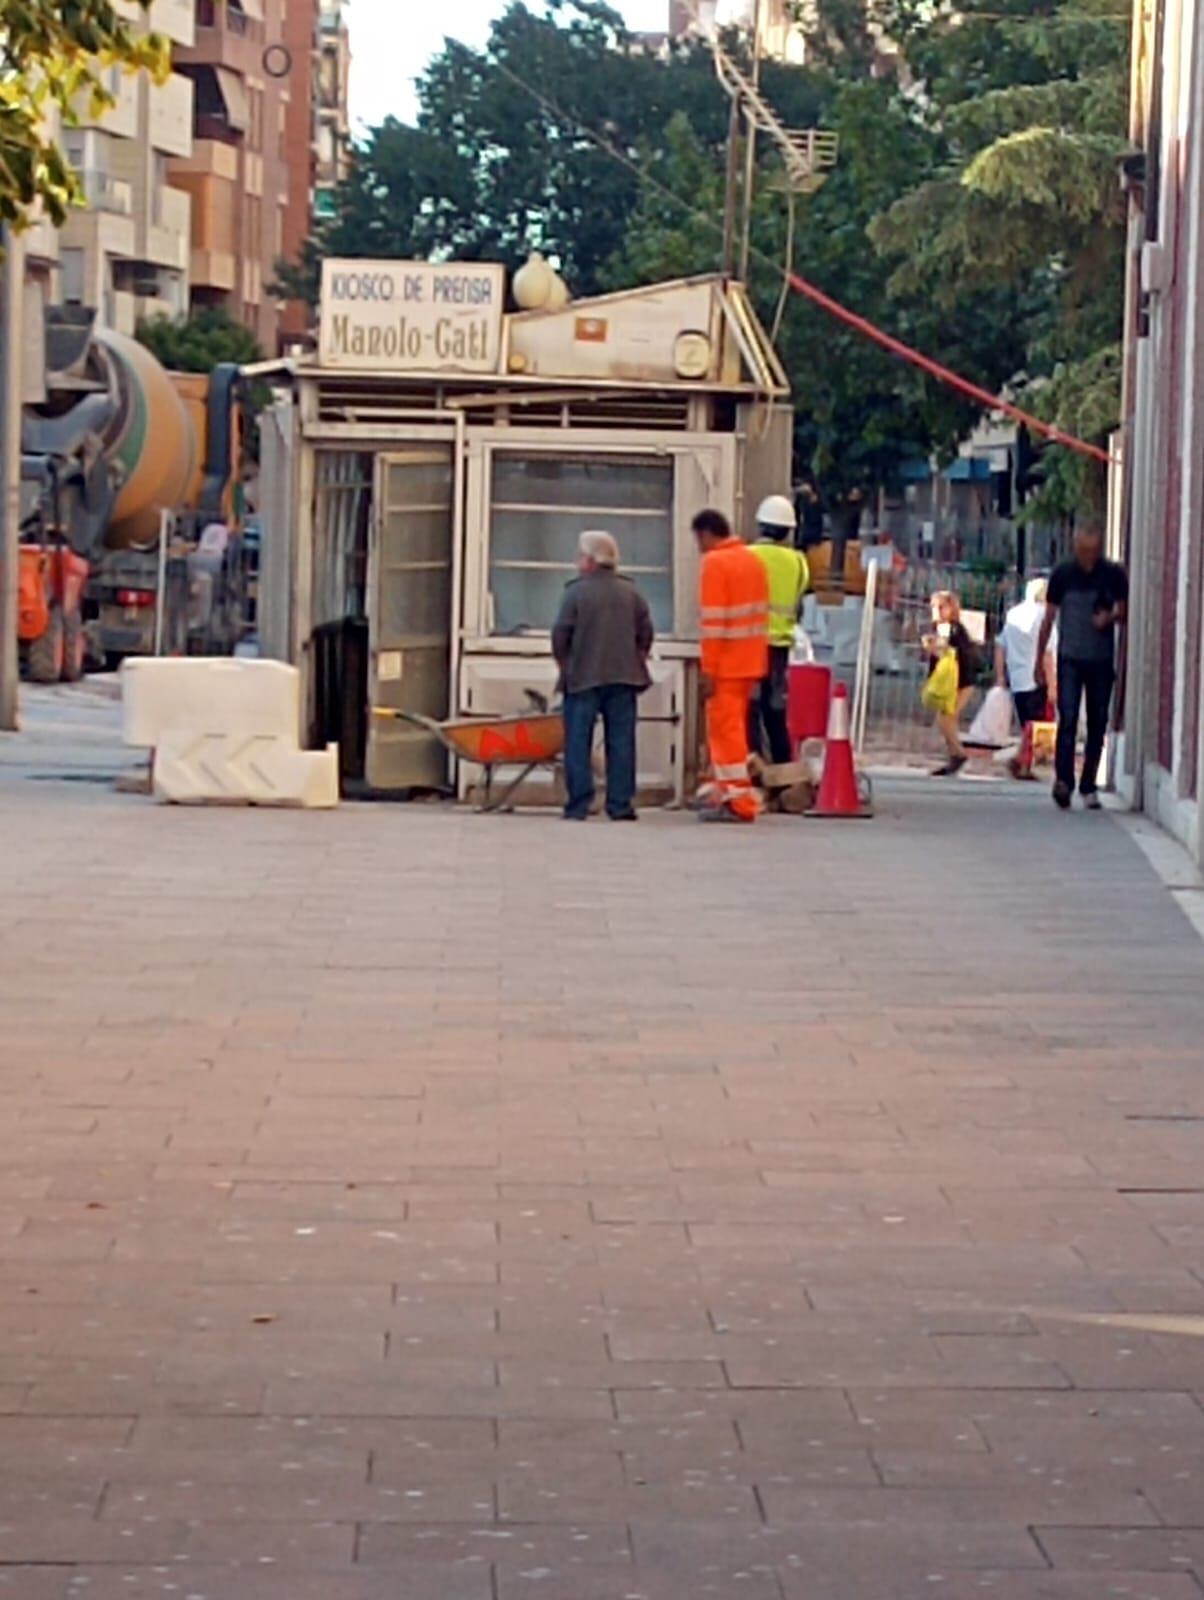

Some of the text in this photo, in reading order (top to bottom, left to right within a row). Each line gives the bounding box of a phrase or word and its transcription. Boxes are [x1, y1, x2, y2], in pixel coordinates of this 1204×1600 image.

[331, 272, 492, 304] KIOSCO DE PRENSA
